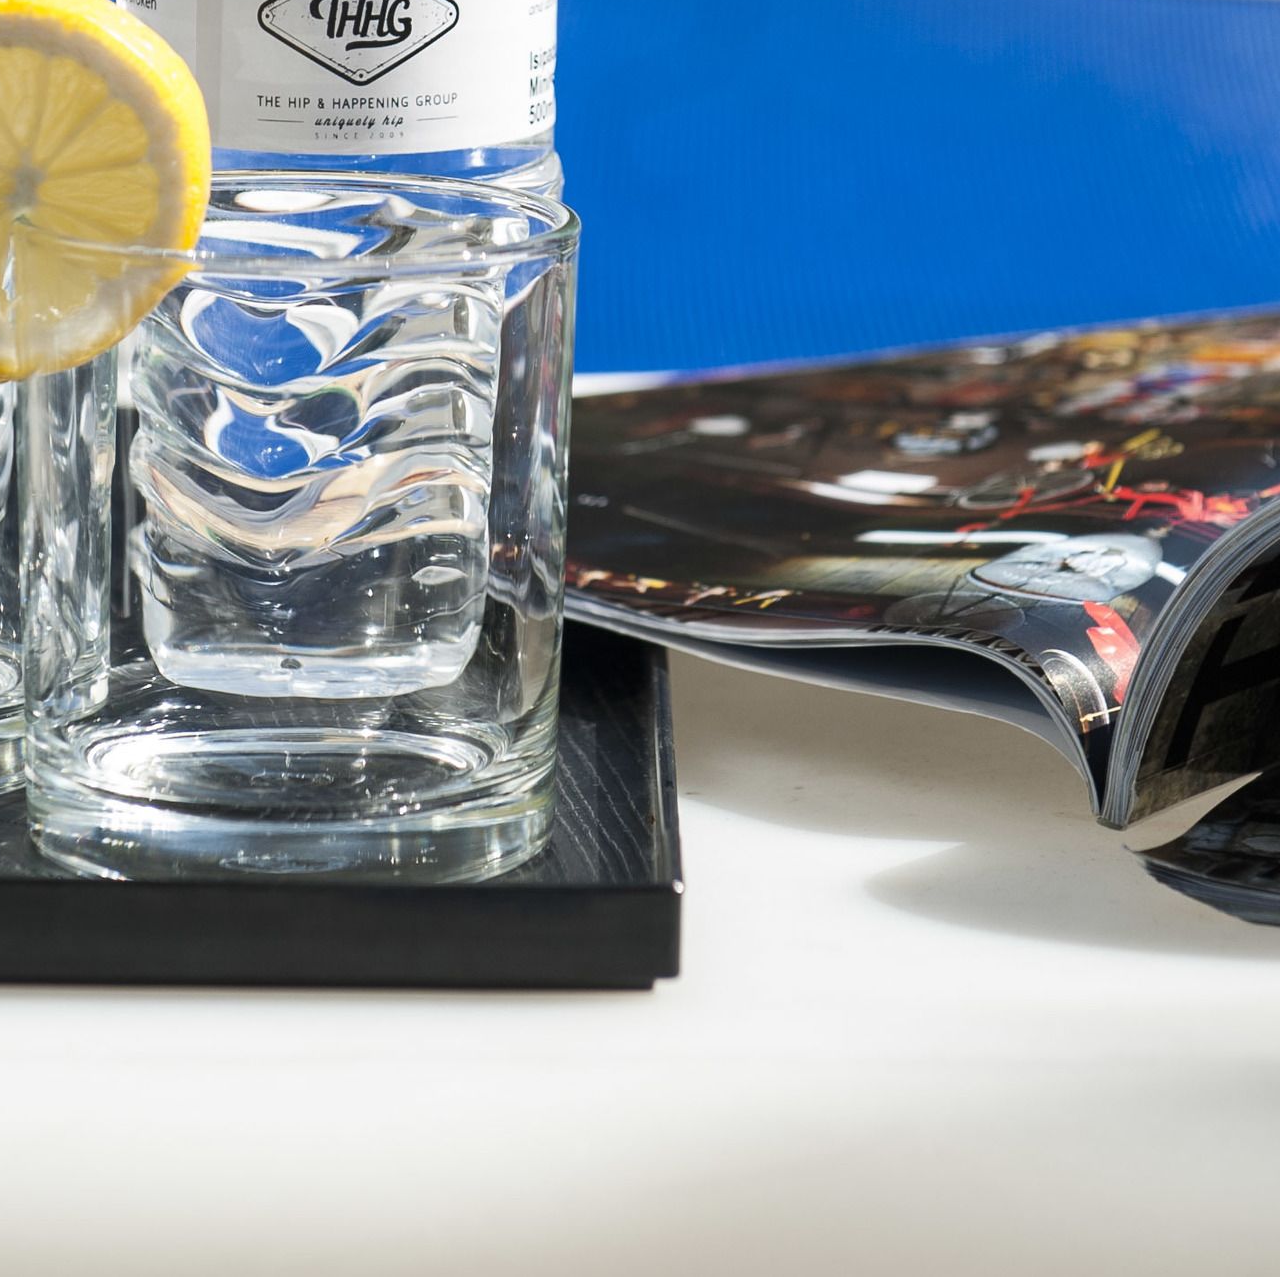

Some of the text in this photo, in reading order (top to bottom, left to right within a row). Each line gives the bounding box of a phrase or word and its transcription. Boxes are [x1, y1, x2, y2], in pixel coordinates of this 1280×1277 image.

[257, 92, 458, 110] THE HIP & HAPPENING GROUP
[314, 115, 404, 130] uniquely hip
[315, 132, 359, 140] SINCE
